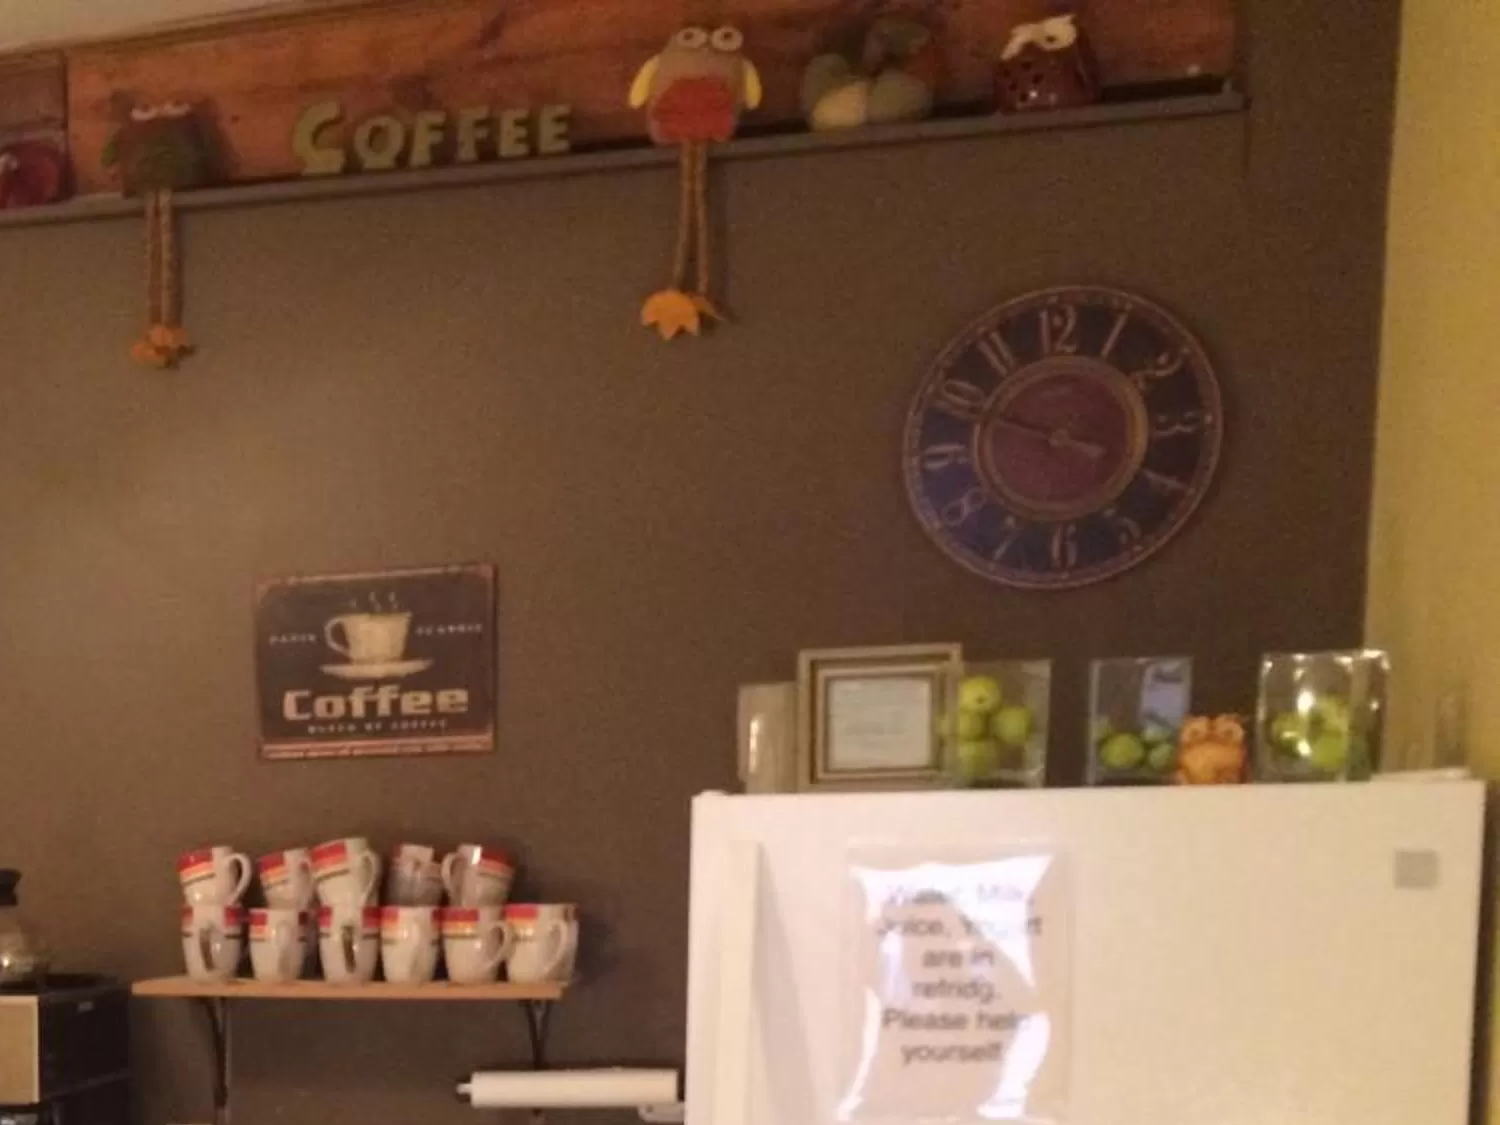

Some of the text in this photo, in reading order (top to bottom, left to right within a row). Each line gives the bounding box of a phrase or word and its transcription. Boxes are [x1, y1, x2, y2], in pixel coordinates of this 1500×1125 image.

[291, 100, 572, 176] COFFEE
[1039, 304, 1078, 353] 12
[283, 683, 469, 721] Coffee
[882, 1008, 968, 1030] Please
